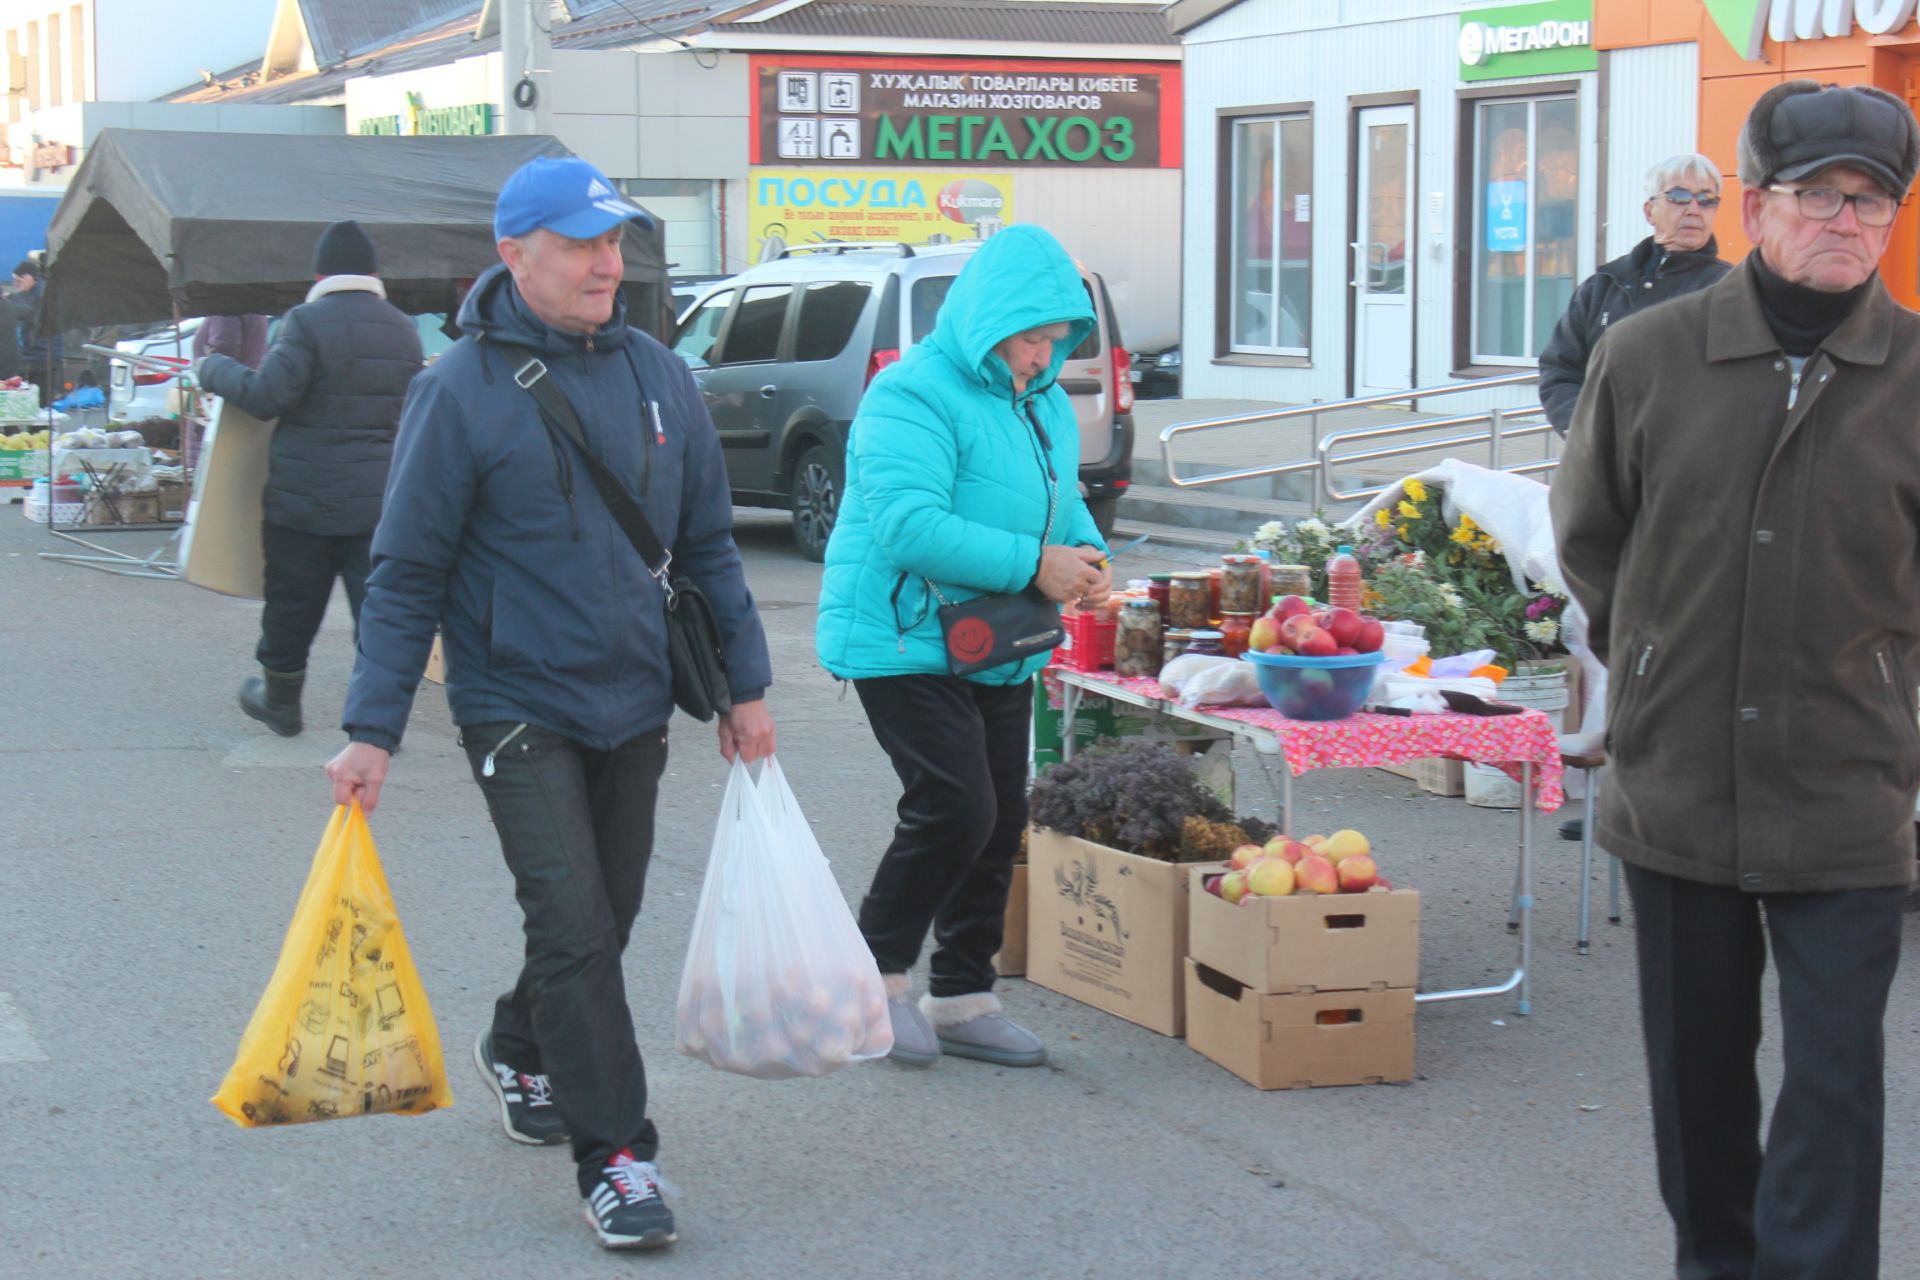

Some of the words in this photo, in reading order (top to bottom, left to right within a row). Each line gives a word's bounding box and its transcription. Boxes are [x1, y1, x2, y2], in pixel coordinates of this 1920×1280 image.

[1485, 20, 1590, 54] МЕГАФОН
[970, 75, 1074, 92] ТОВАРЛАРЫ
[1078, 77, 1138, 93] КИБЕТЕ
[903, 93, 986, 109] МАГАЗИН
[988, 94, 1102, 110] ХОЗТОВАРОВ
[757, 177, 928, 209] ПОСУДА
[1493, 226, 1520, 240] YOTA
